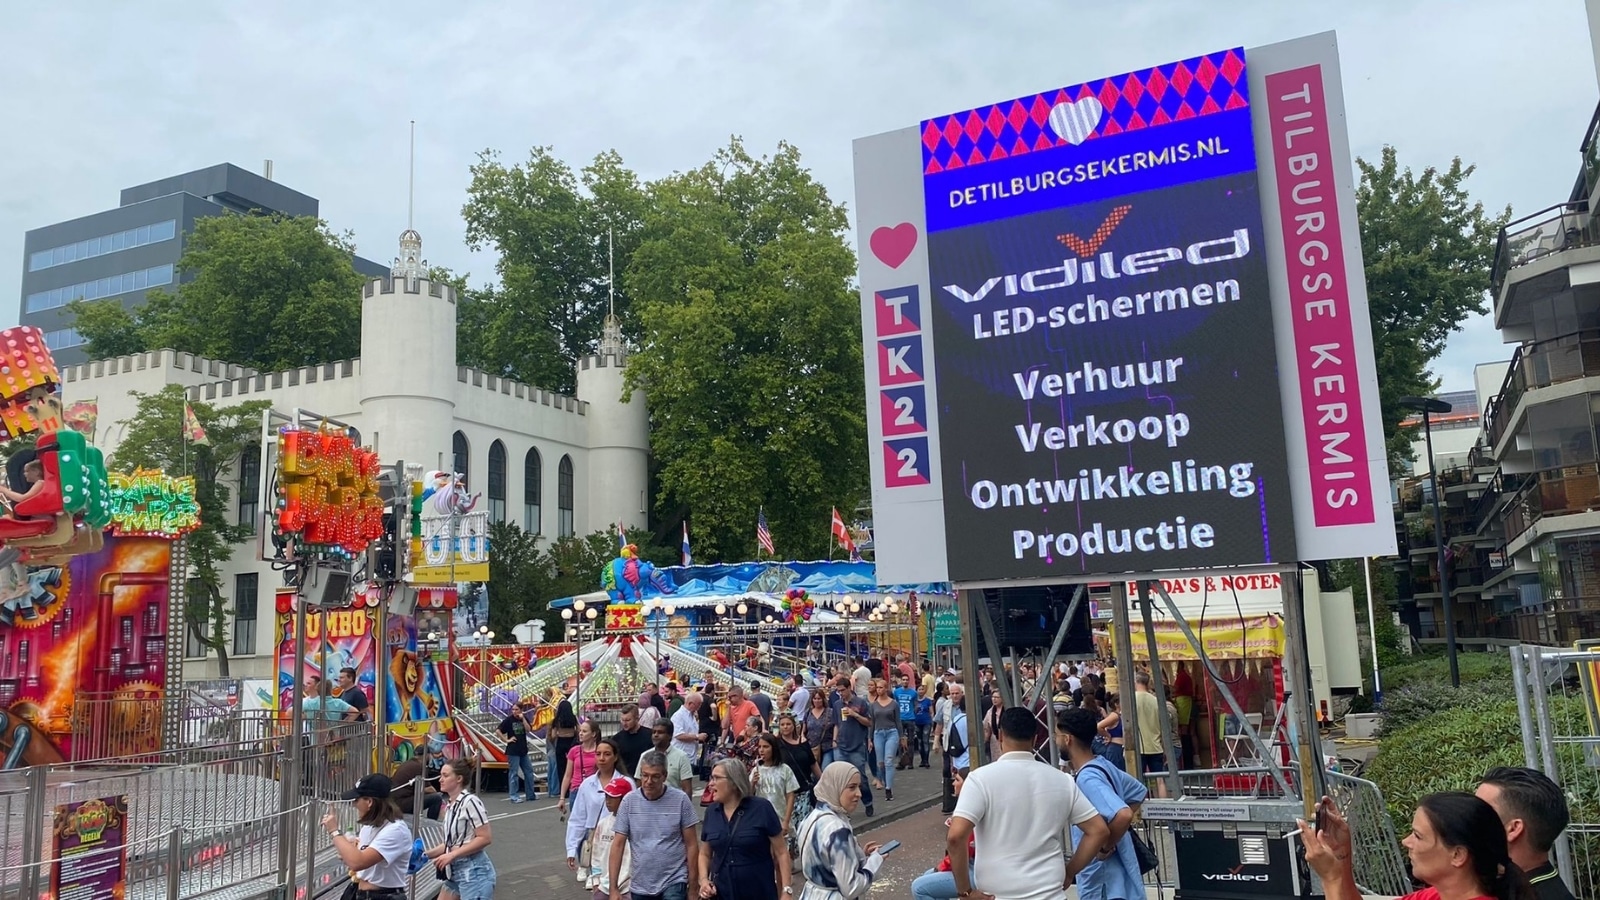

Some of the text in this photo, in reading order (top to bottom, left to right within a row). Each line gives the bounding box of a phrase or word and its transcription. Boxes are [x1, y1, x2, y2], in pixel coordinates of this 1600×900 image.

[948, 136, 1229, 208] DETILBURGSEKERMIS.NL
[973, 276, 1241, 339] LED-schermen
[1281, 82, 1358, 509] TILBURGSE KERMIS
[1013, 357, 1183, 400] Verhuur
[1015, 411, 1190, 453] Verkoop
[972, 459, 1255, 509] Ontwikkeling
[1013, 515, 1215, 559] Productie
[1128, 578, 1199, 596] PDA'S
